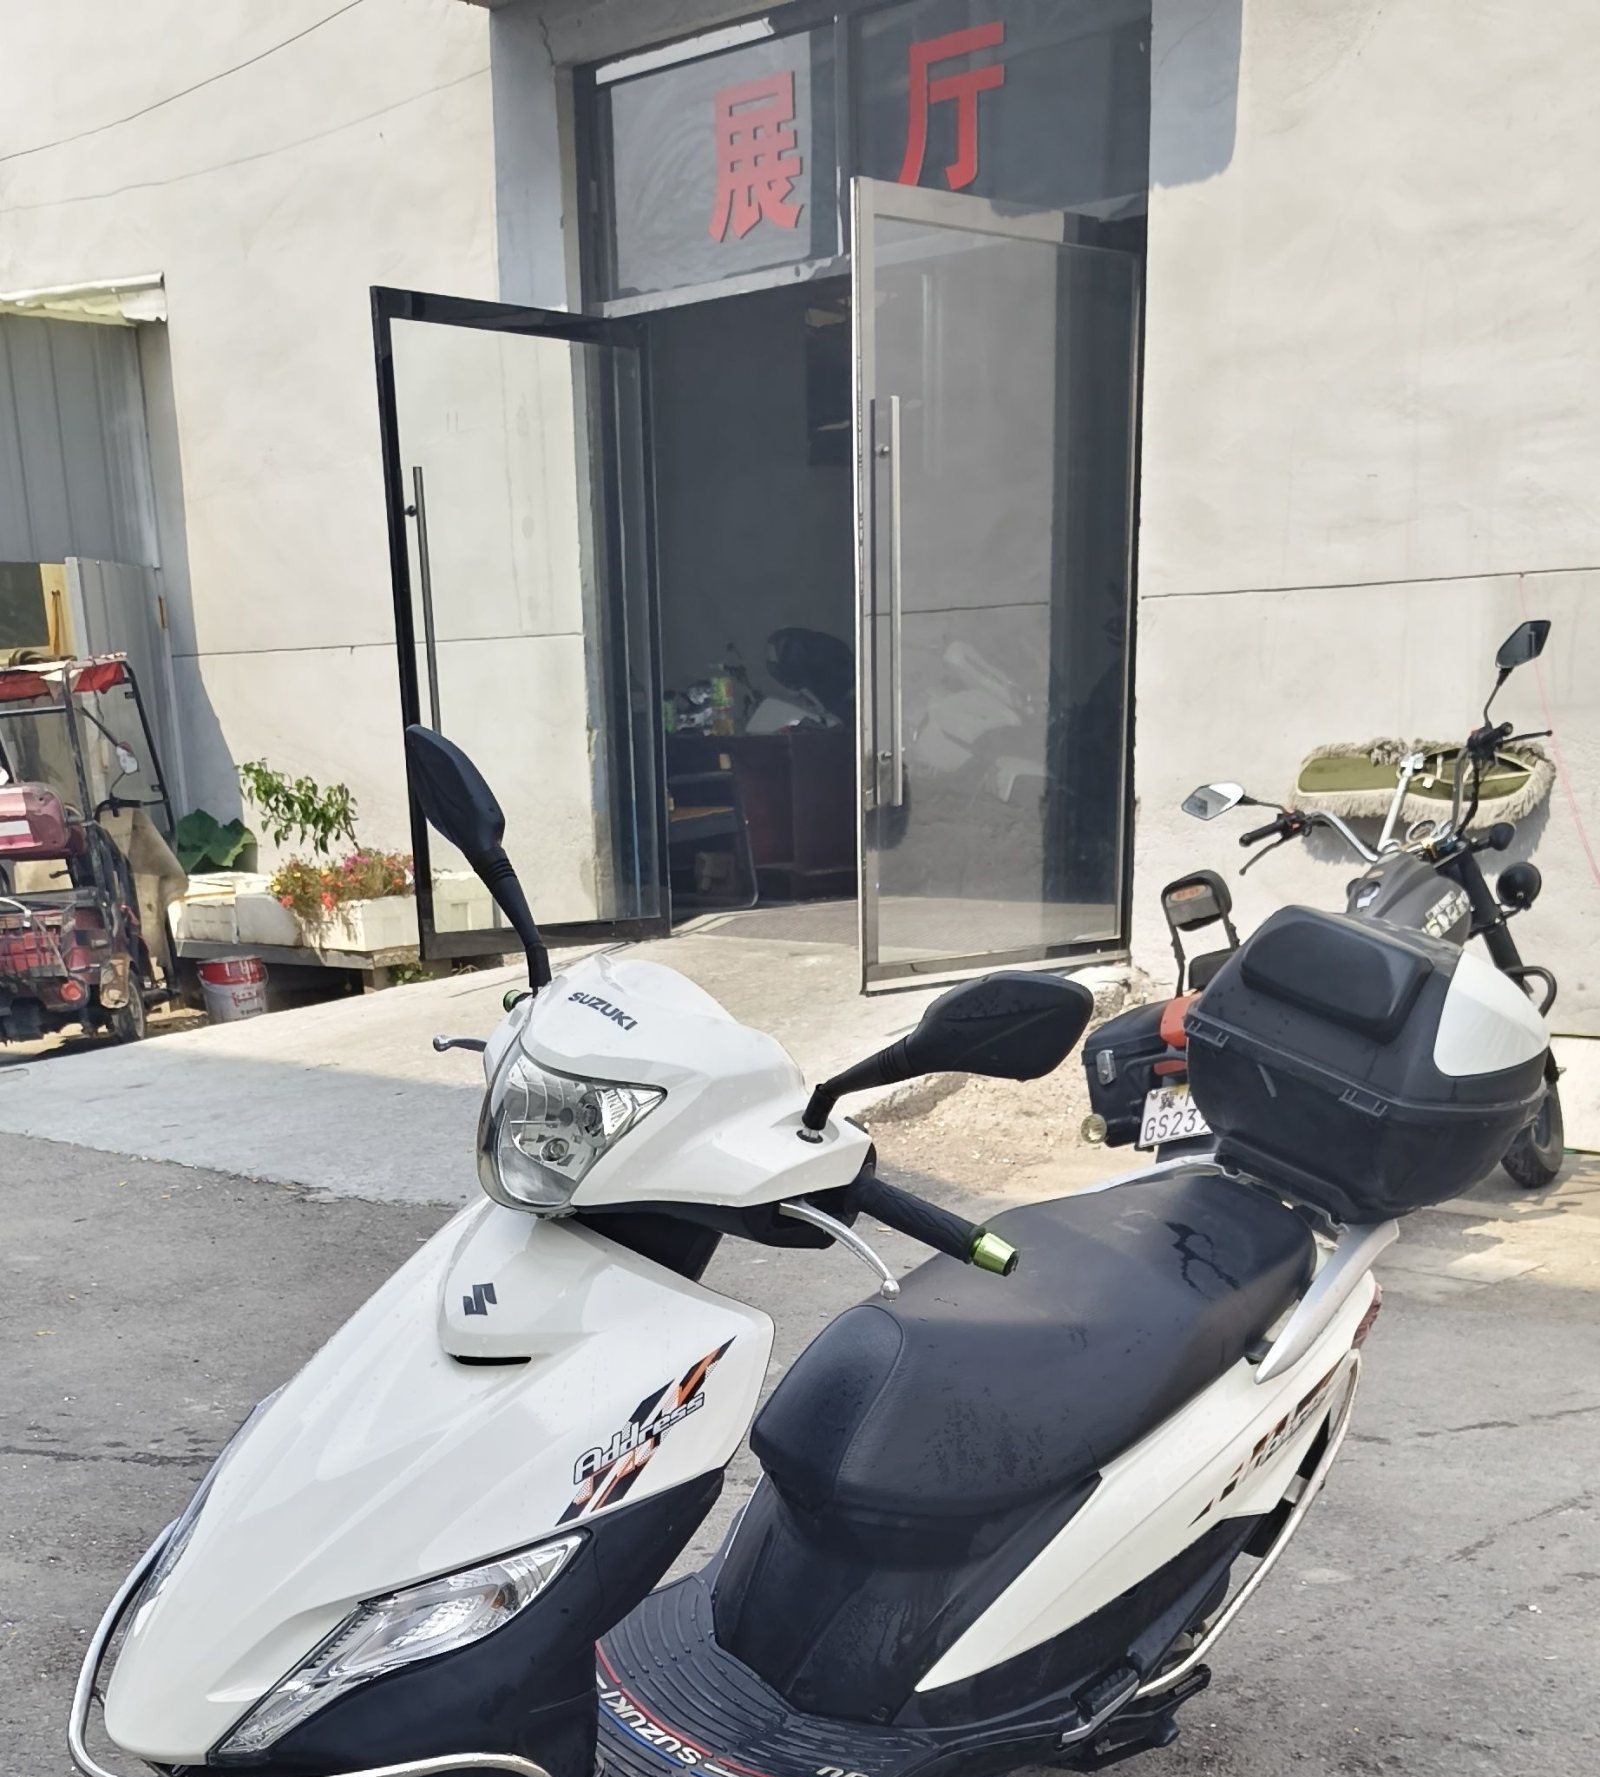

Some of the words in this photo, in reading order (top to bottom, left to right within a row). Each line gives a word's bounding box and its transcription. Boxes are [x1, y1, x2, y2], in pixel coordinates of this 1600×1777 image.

[708, 21, 1005, 244] 展厅
[567, 991, 639, 1032] SUZUKI
[572, 1391, 706, 1486] Address
[600, 1690, 703, 1765] SUZUKI
